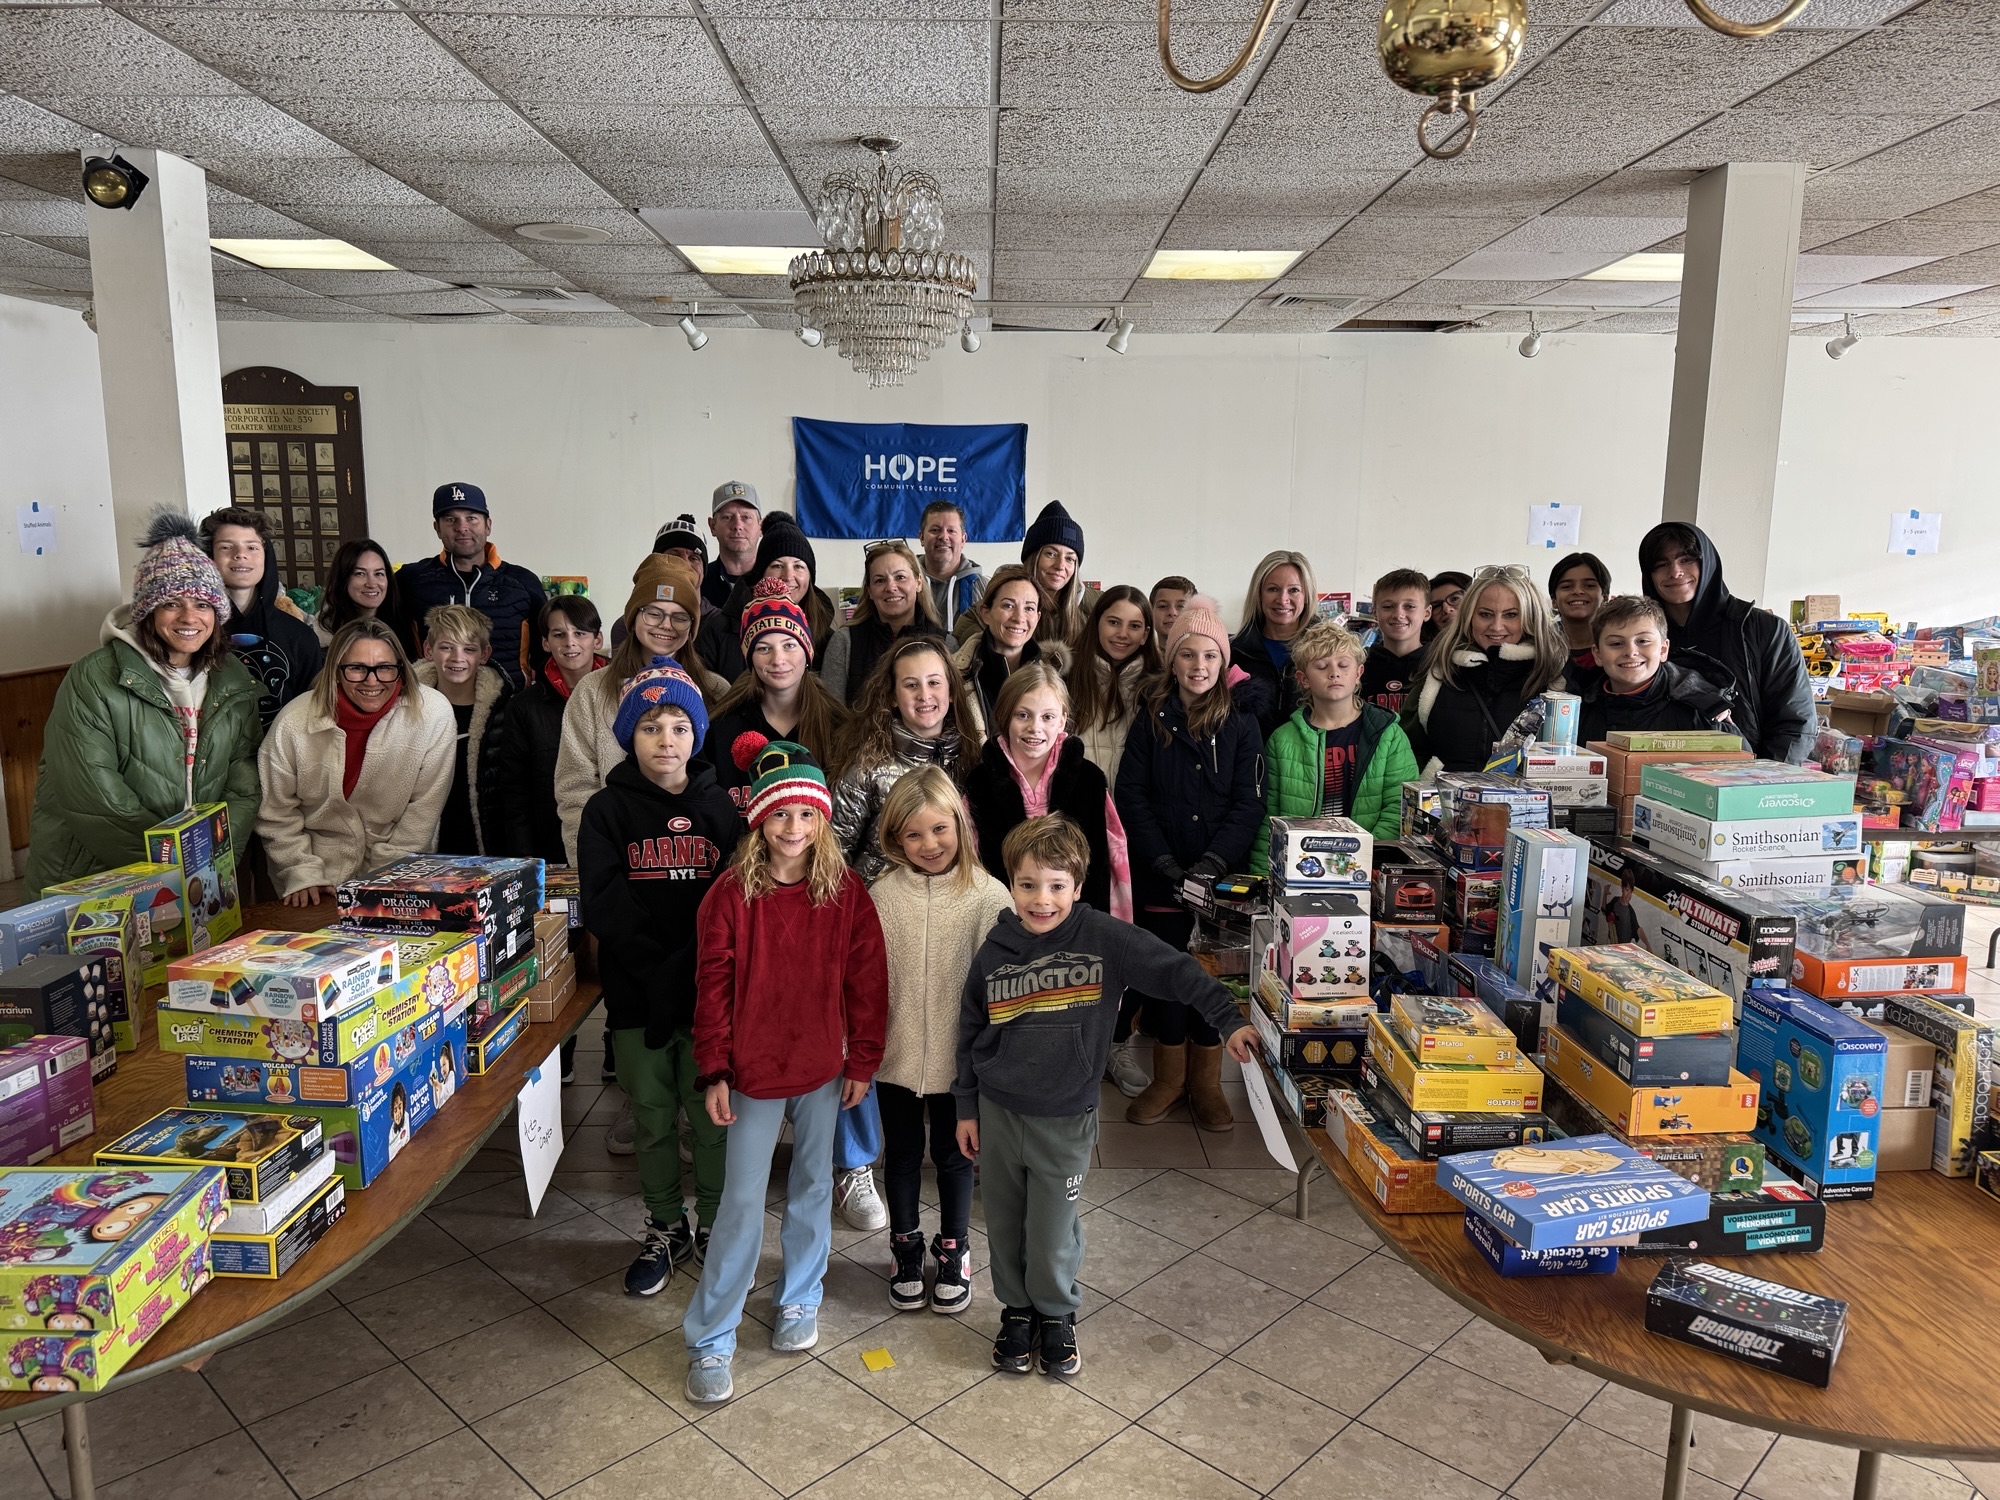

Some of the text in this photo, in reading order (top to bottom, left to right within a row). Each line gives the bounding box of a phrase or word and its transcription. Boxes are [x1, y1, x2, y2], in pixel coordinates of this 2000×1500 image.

[244, 407, 277, 415] MUTUAL
[297, 408, 331, 416] SOCIETY
[267, 424, 303, 432] MEMBERS
[864, 453, 957, 483] HOPE
[865, 483, 958, 493] COMMUNITY SERVICES
[785, 620, 798, 631] OF
[1652, 818, 1697, 846] Smithsonian
[1732, 829, 1821, 846] Smithsonian
[1732, 843, 1786, 853] Rocket Science
[669, 869, 696, 881] RYE
[1738, 871, 1826, 888] Smithsonian
[142, 880, 164, 891] Forest
[381, 898, 430, 908] DRAGON
[392, 907, 421, 916] DUEL
[1680, 896, 1739, 936] ULTIMATE
[1690, 919, 1709, 933] STUNT
[341, 966, 377, 990] RAINBOW
[350, 980, 370, 994] SOAP
[264, 992, 295, 1000] RAINBOW
[382, 994, 420, 1021] CHEMISTRY
[388, 1005, 417, 1027] STATION
[1884, 1003, 1955, 1047] KidzRobotix
[209, 1028, 260, 1038] CHEMISTRY
[216, 1036, 254, 1045] STATION
[1842, 1042, 1884, 1051] Discovery
[262, 1062, 296, 1070] VOLCANO
[268, 1068, 290, 1077] LAB
[410, 1083, 429, 1106] Deluxe
[410, 1093, 430, 1118] Lab Set
[1655, 1152, 1704, 1161] MINECRAFT
[1066, 1174, 1083, 1188] GAP
[1452, 1174, 1516, 1229] SPORTS CAR
[1541, 1184, 1673, 1218] SPORTS CAR
[1758, 1210, 1792, 1220] ENSEMBLE
[1574, 1209, 1670, 1242] SPORTS CAR
[1736, 1217, 1783, 1229] PRENDRE VIE
[162, 1224, 175, 1238] FIRST
[1747, 1232, 1763, 1241] MIRA
[1786, 1228, 1811, 1237] COBRA
[1758, 1234, 1800, 1245] VIDA TU SET
[1682, 1262, 1825, 1306] BRAINBOLT
[1688, 1315, 1785, 1355] BRAINBOLT
[1717, 1340, 1750, 1356] GENIUS
